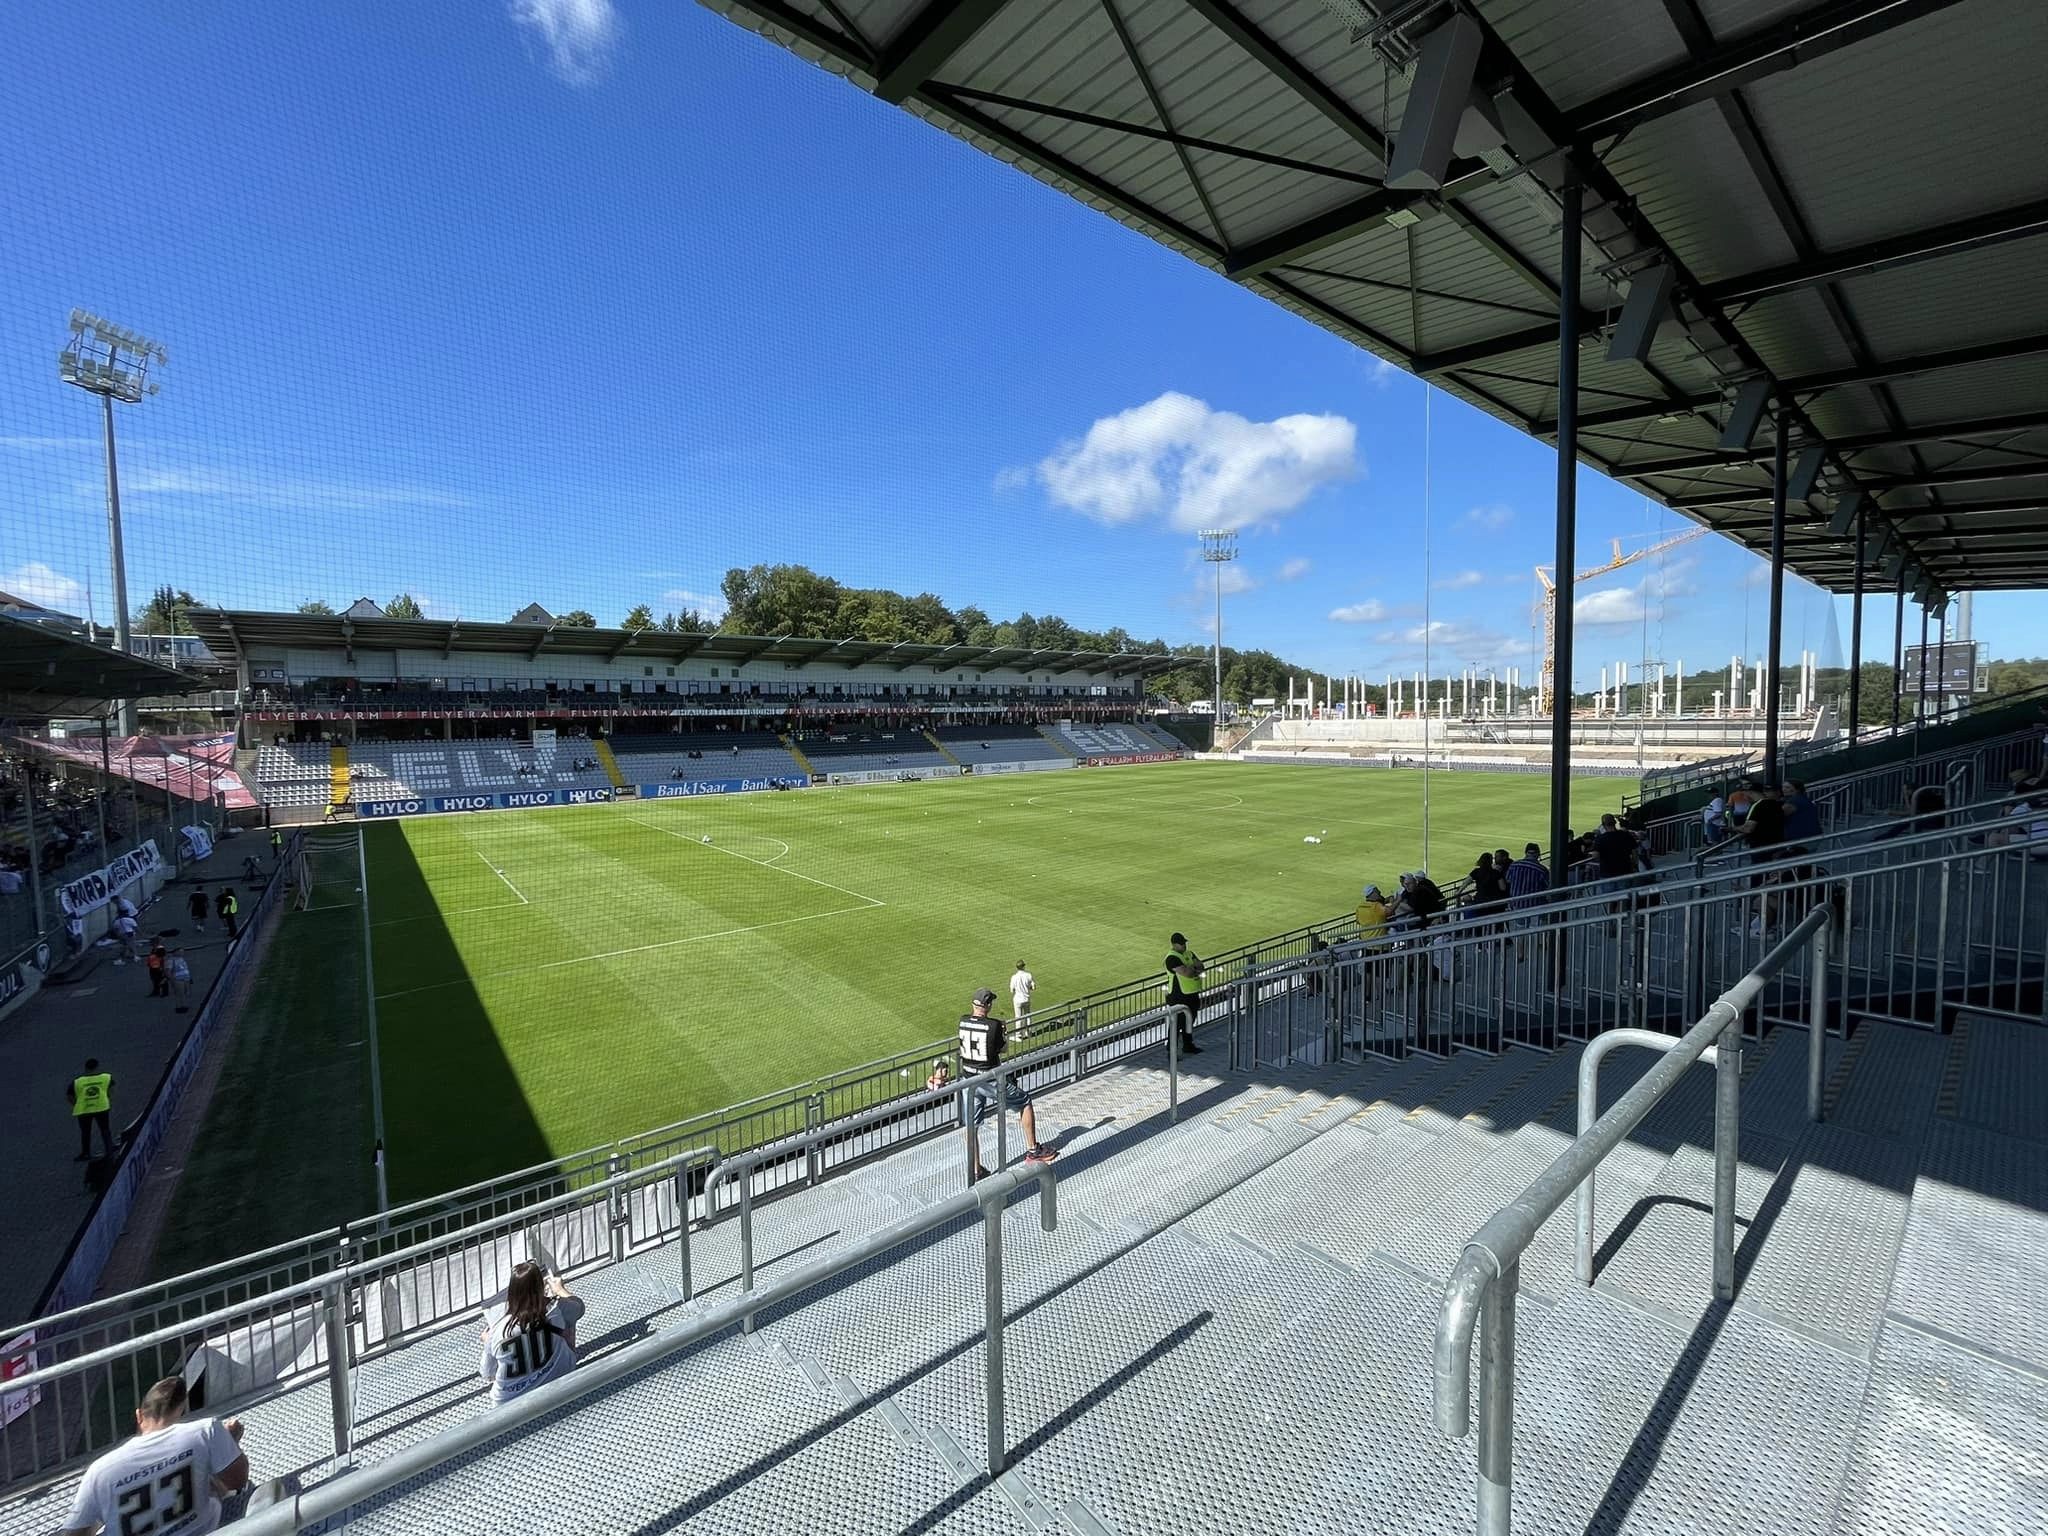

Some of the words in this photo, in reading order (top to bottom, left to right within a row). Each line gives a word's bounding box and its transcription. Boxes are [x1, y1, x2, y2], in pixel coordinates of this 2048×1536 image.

[244, 712, 379, 721] FLYERALARM
[421, 711, 535, 719] FLYERALARM
[571, 709, 668, 717] FLYERALARM
[443, 797, 487, 811] HYLO
[509, 793, 548, 806] HYLO
[372, 801, 419, 816] HYLO
[114, 1449, 194, 1489] AUFSTEIGER
[118, 1464, 193, 1536] 23
